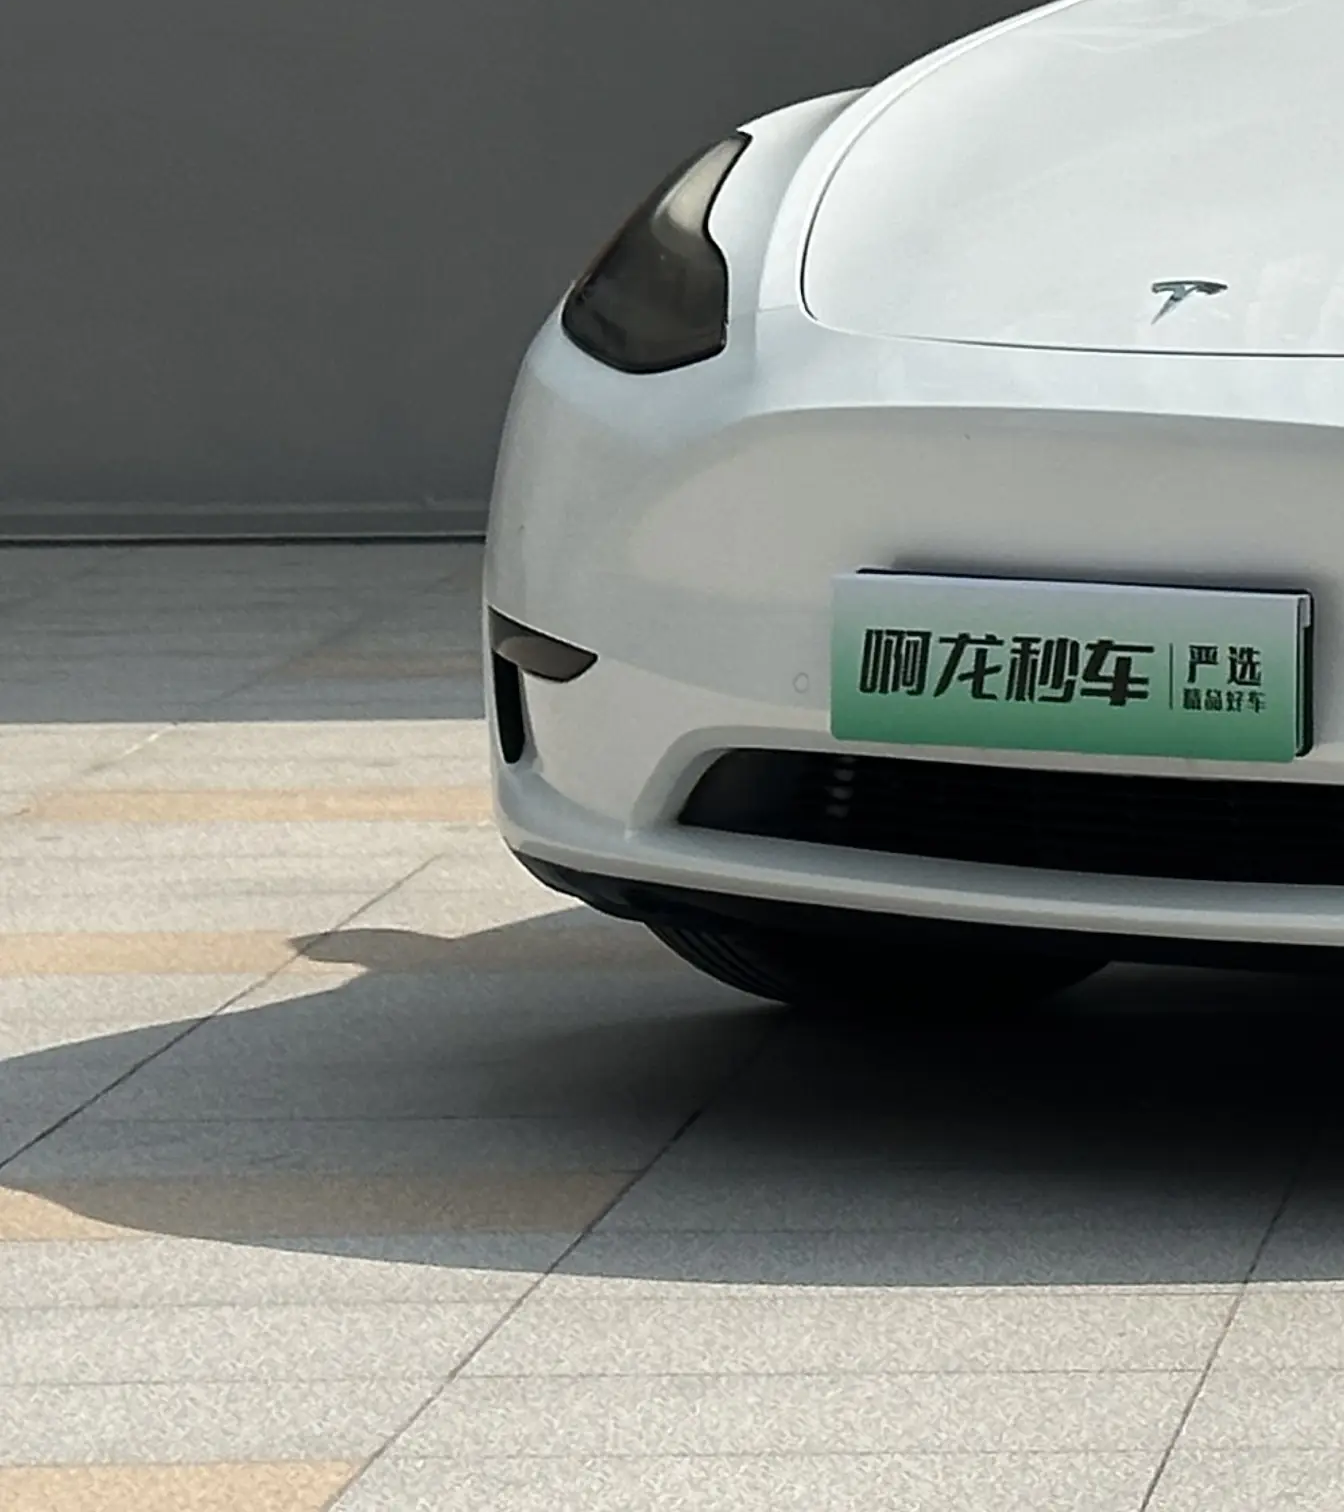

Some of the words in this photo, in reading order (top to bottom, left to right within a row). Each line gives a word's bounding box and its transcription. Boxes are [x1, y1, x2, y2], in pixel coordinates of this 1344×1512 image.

[859, 628, 1155, 707] 啊龙秒车
[1187, 644, 1262, 686] 严选
